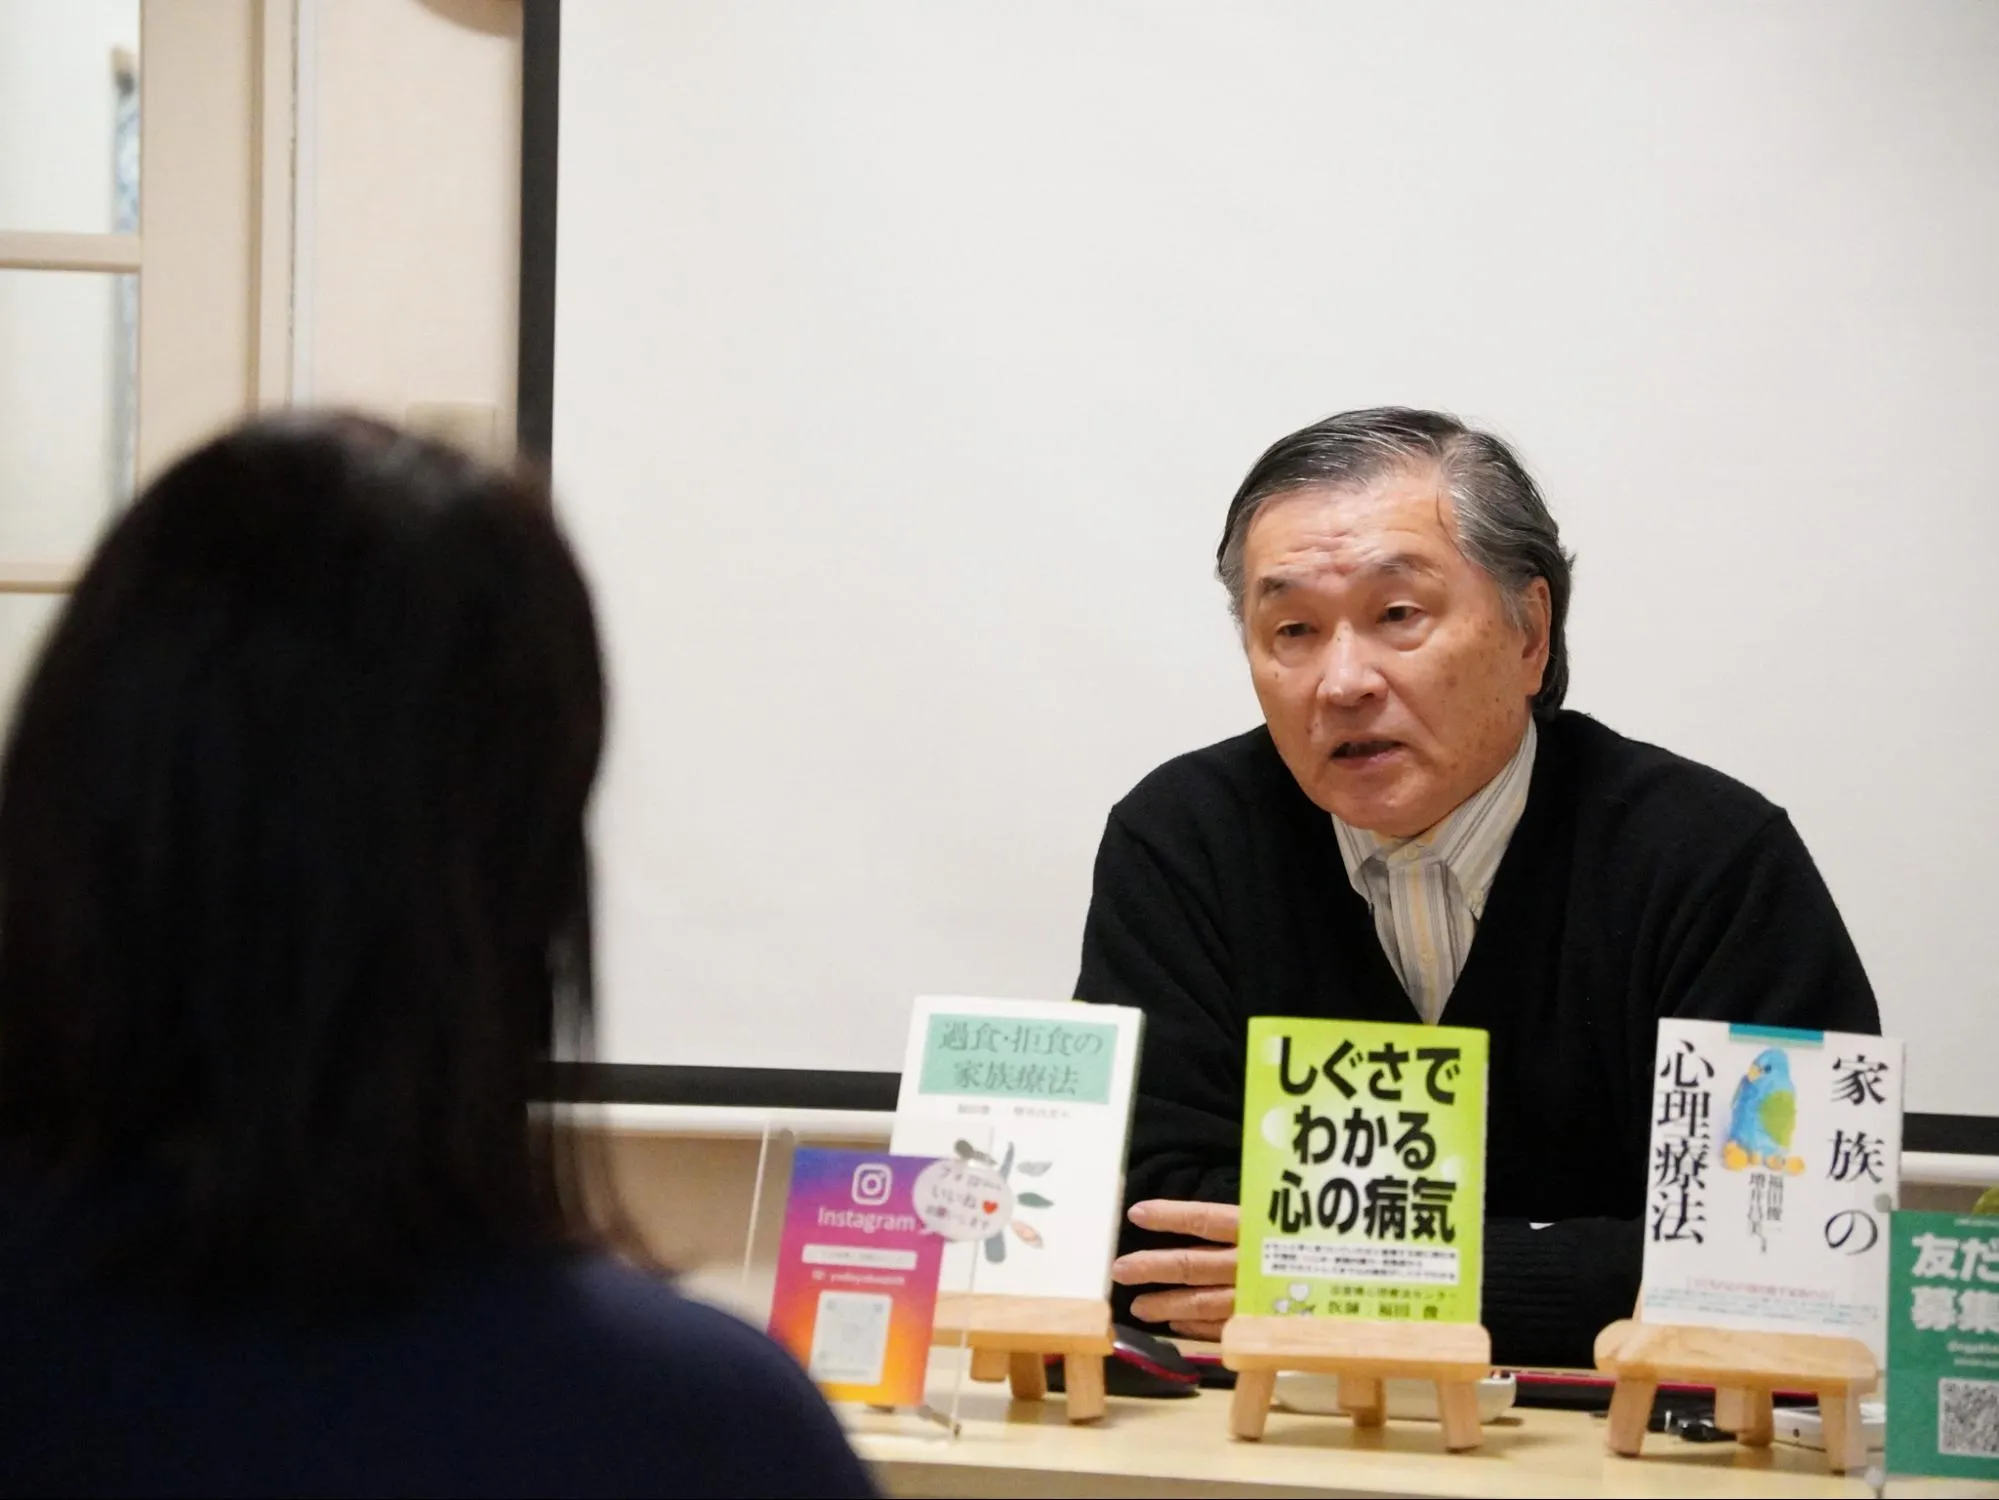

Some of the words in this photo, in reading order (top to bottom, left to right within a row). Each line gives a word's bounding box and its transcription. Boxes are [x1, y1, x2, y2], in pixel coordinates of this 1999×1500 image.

[953, 1060, 1080, 1096] 家族療法
[1279, 1036, 1462, 1106] しぐさで
[1291, 1104, 1438, 1172] わかる
[1651, 1039, 1715, 1246] 心理療法
[1823, 1053, 1890, 1256] 家族の
[817, 1205, 917, 1234] Instagram
[1267, 1169, 1457, 1244] 心の病気
